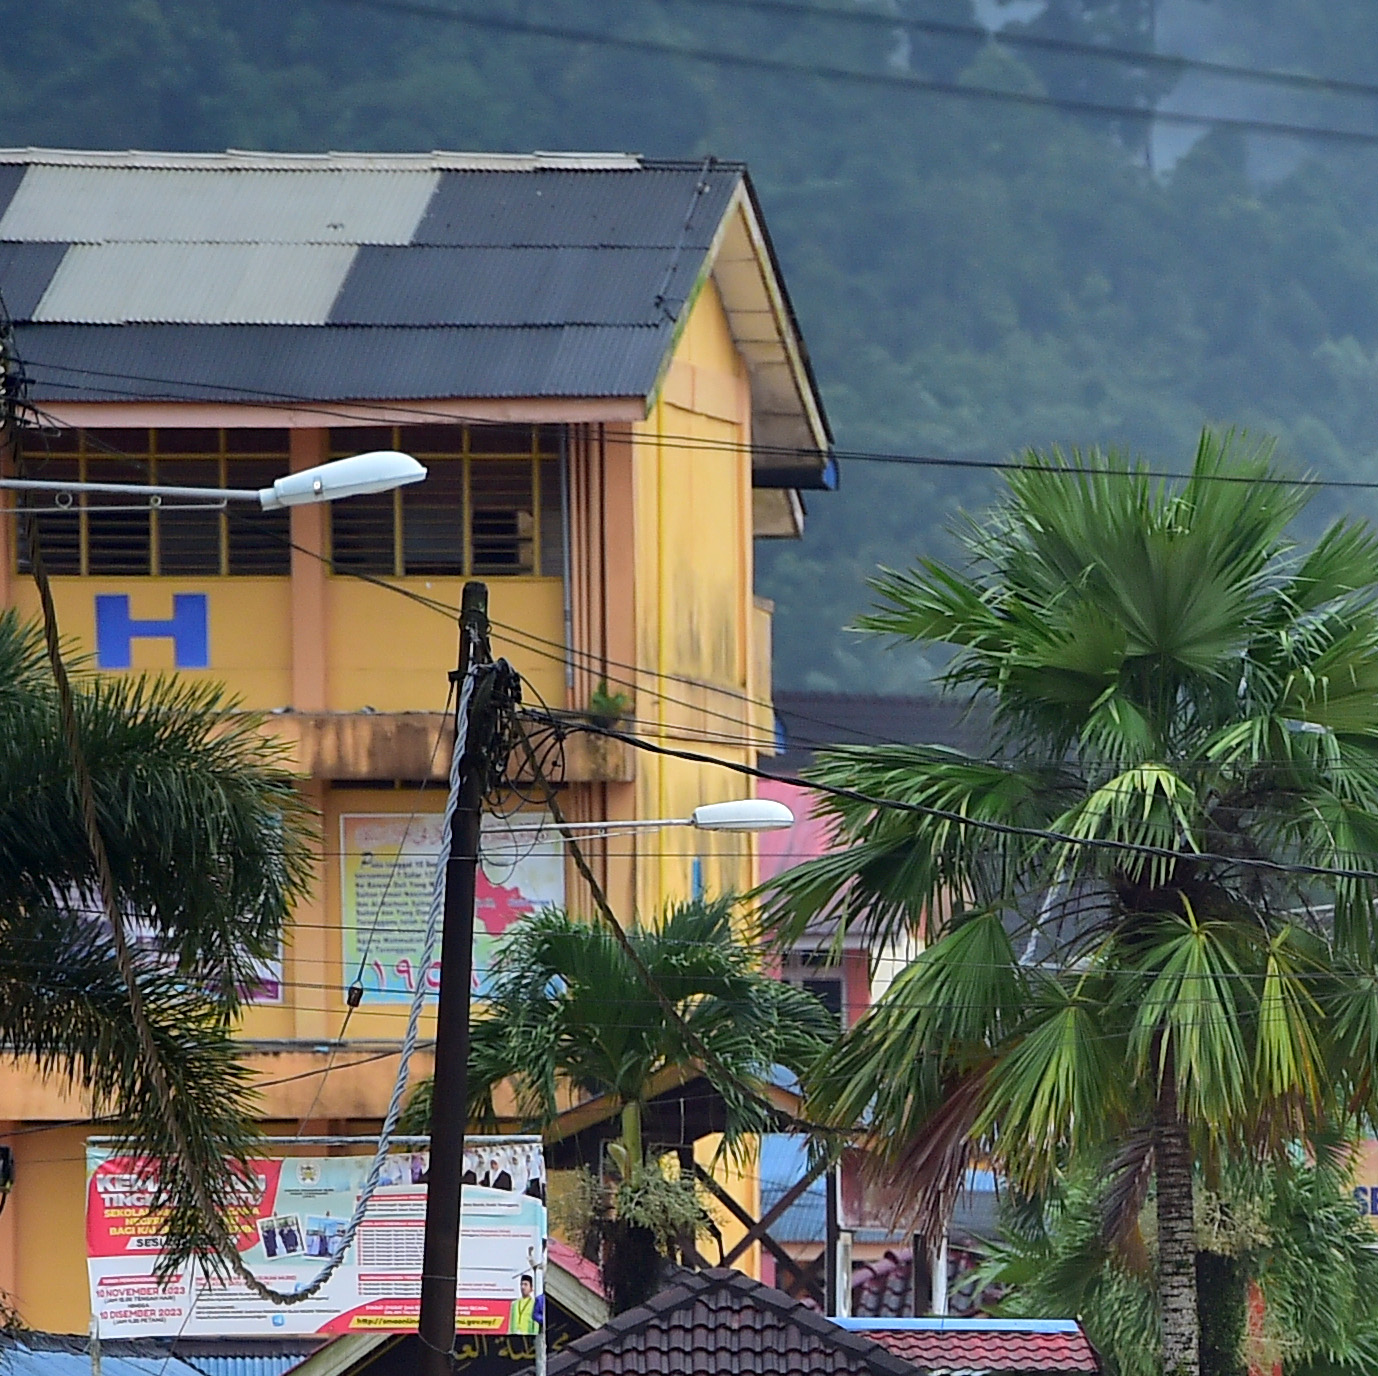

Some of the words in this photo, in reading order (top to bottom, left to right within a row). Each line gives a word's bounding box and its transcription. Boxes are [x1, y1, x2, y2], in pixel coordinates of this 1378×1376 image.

[96, 594, 208, 669] H
[106, 1287, 159, 1298] NOVEMBER
[110, 1309, 156, 1319] DISEMBER
[158, 1308, 183, 1317] 2023
